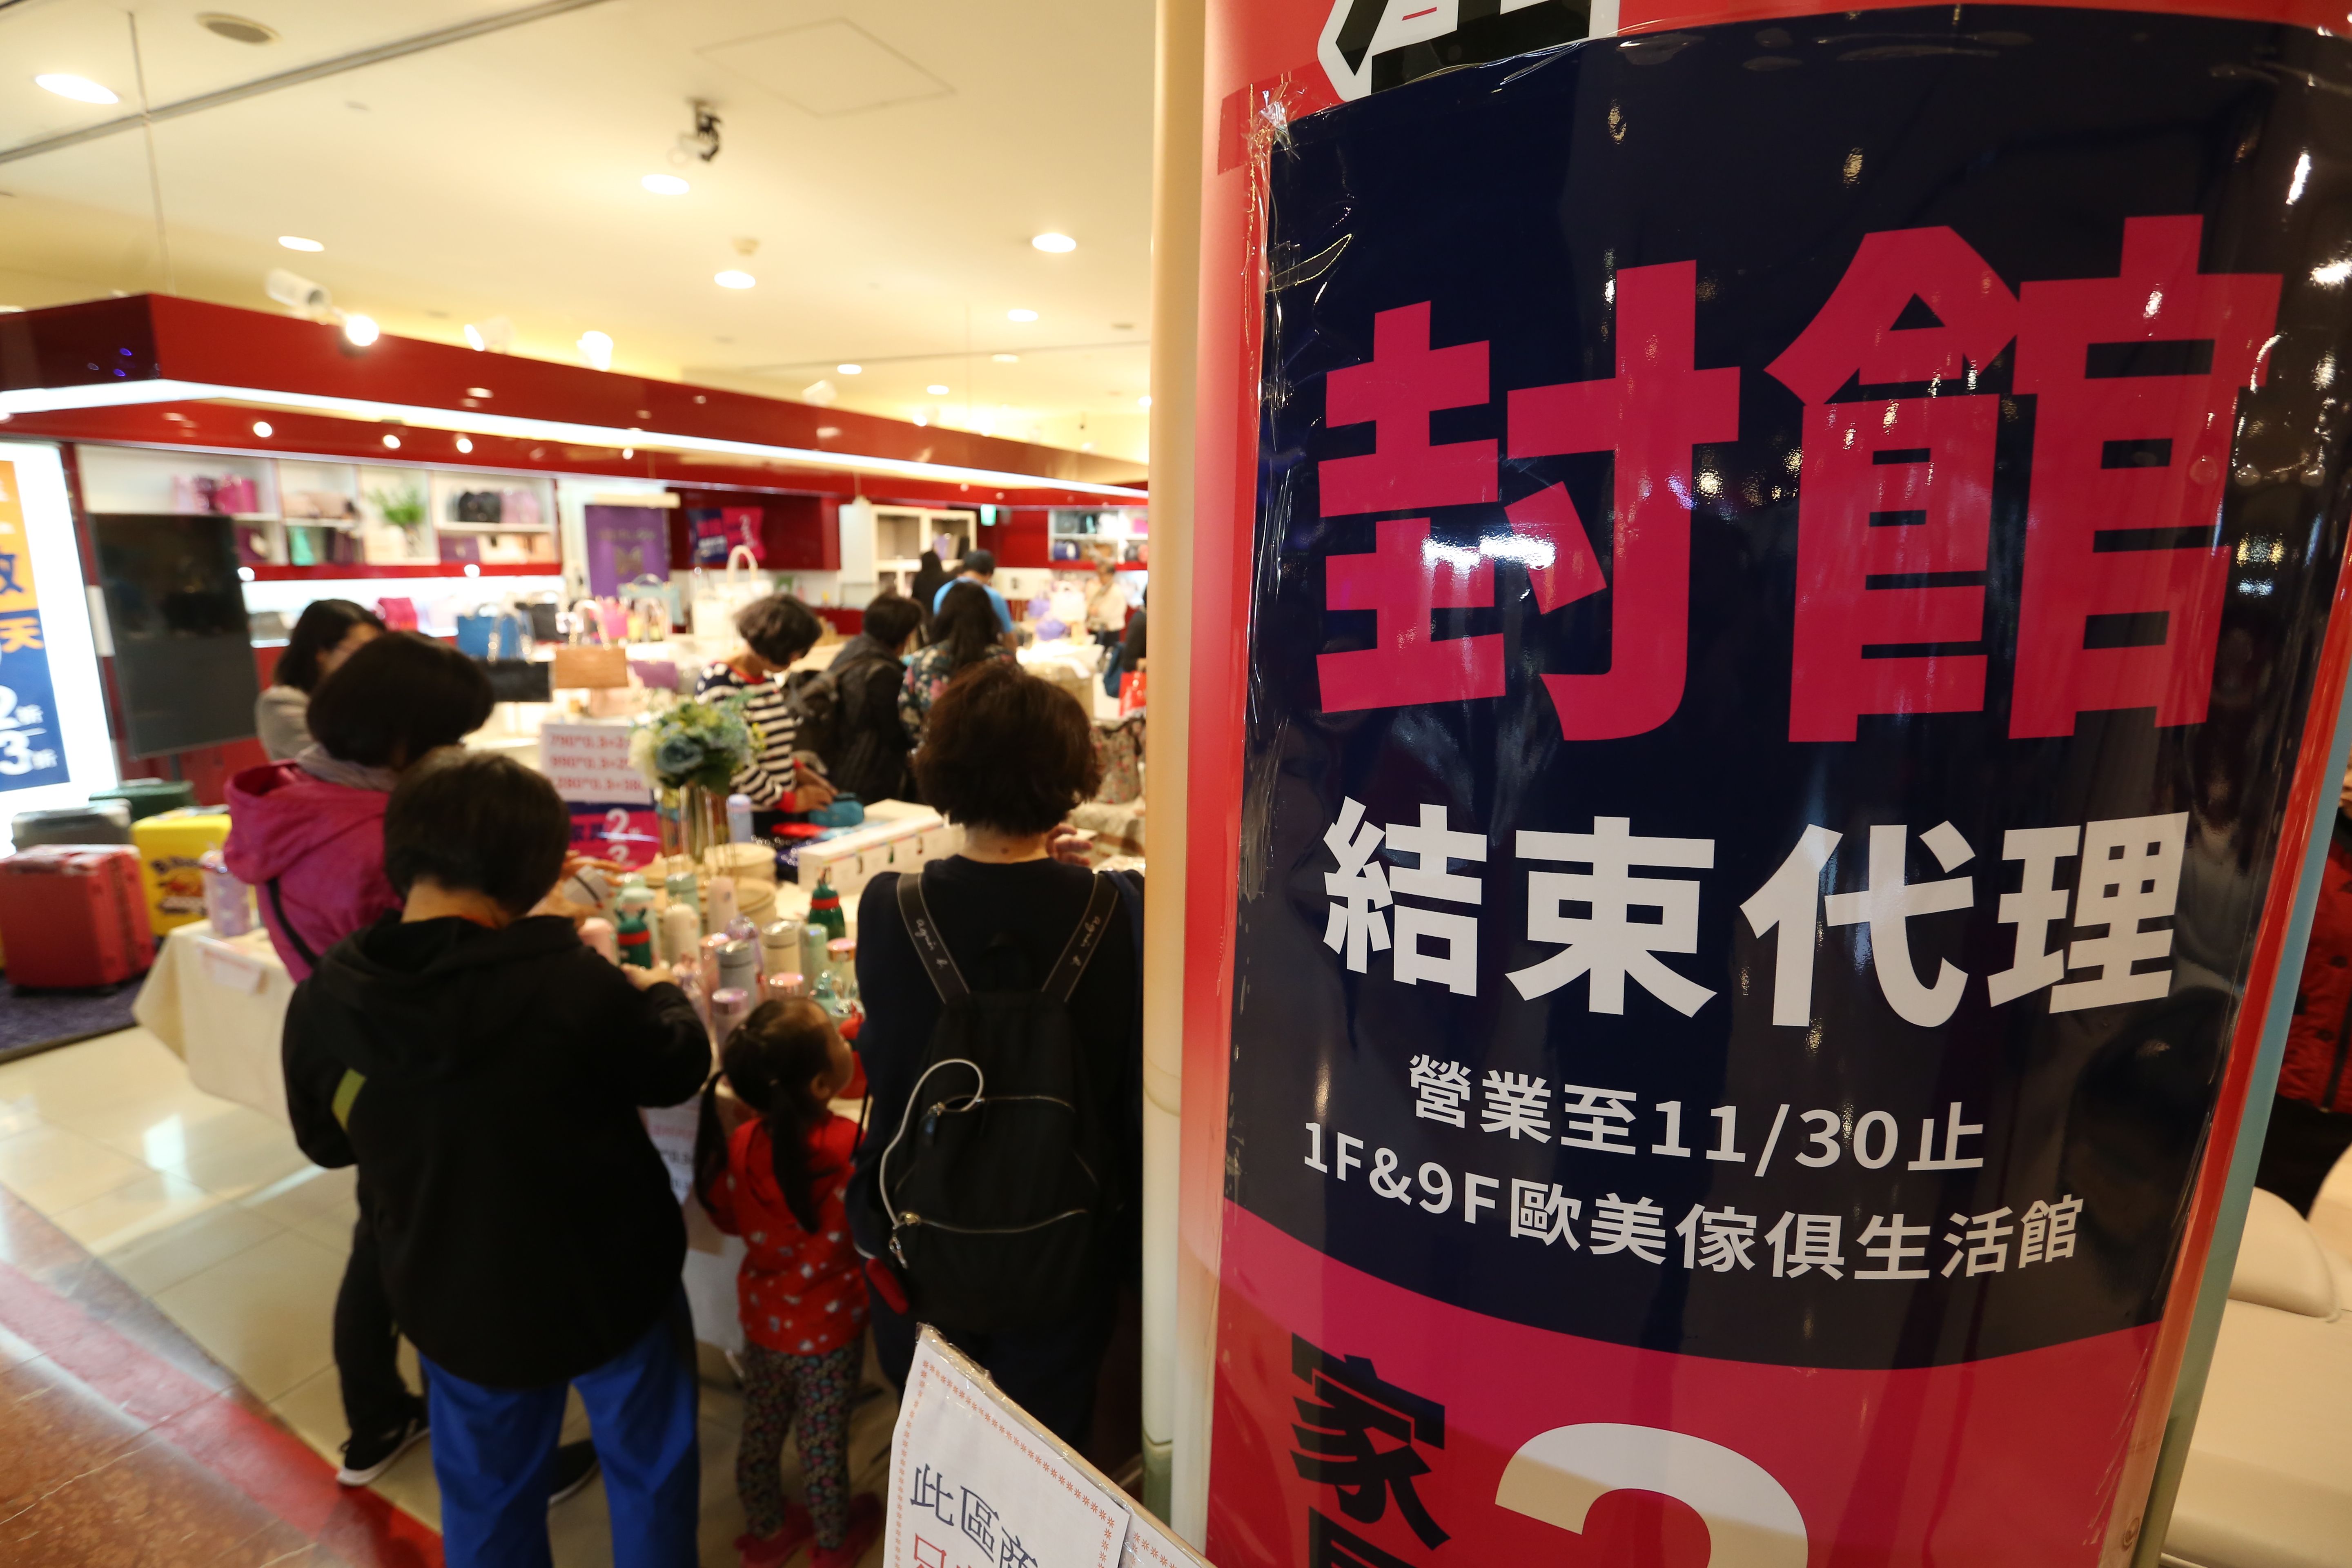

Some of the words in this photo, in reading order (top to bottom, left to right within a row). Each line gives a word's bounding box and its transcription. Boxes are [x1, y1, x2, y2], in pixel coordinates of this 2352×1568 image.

[1317, 214, 2283, 743] 封館
[1323, 795, 2189, 1027] 結束代理
[1303, 1122, 2084, 1281] 1F&9F歐美傢俱生活館
[1409, 1054, 1985, 1176] 營業至11/30止
